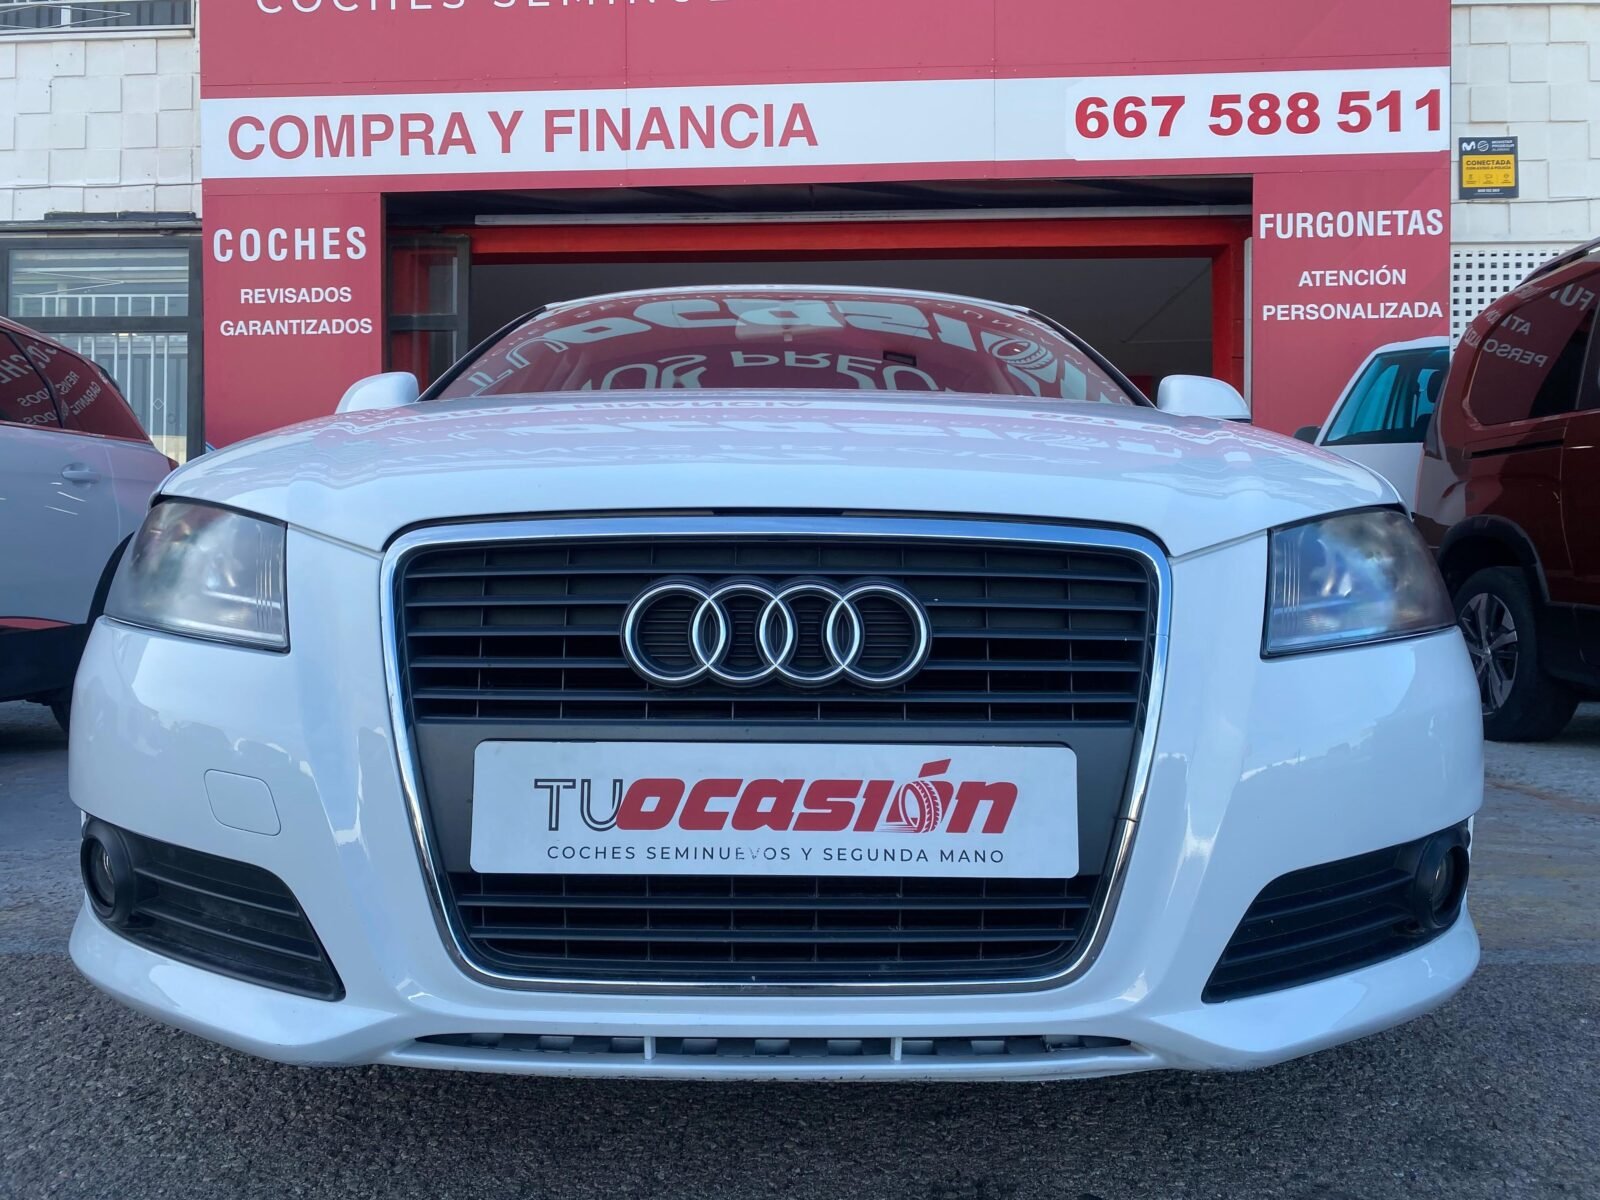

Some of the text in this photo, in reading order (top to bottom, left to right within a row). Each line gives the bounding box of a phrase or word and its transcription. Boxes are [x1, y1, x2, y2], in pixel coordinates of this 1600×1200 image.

[1074, 88, 1441, 139] 667 588 511
[228, 102, 819, 161] COMPRA Y FINANCIA
[1259, 208, 1445, 239] FURGONETAS
[213, 226, 368, 263] COCHES
[1298, 264, 1407, 288] ATENCIÓN
[240, 286, 353, 305] REVISADOS
[1262, 300, 1443, 322] PERSONALIZADA
[219, 317, 374, 337] GARANTIZADOS
[547, 845, 636, 860] COCHES
[800, 847, 813, 861] Y
[823, 847, 929, 862] SEGUNDA
[939, 849, 1004, 864] MANO
